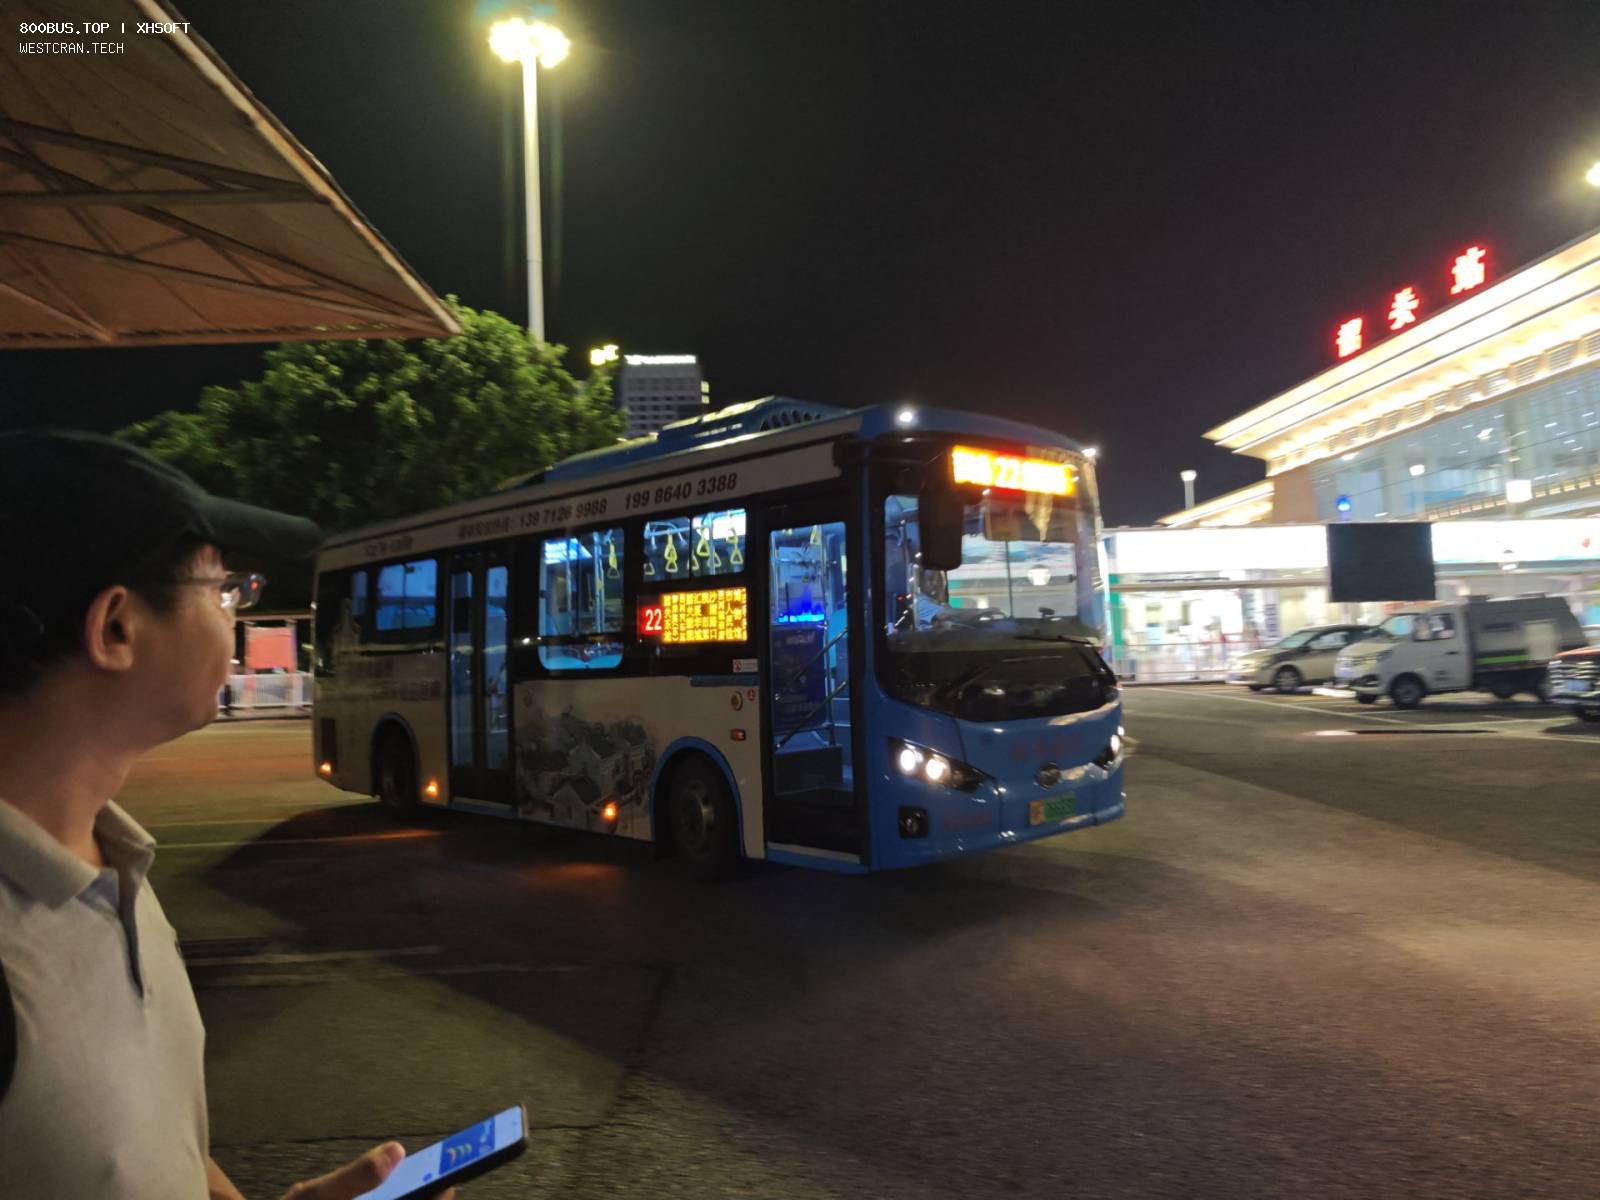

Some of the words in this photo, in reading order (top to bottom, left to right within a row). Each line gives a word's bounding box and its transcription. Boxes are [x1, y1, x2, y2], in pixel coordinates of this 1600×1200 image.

[519, 510, 540, 528] 139
[543, 504, 572, 523] 7126
[576, 498, 607, 519] 9988
[625, 490, 650, 510] 199
[654, 481, 692, 505] 8640
[697, 473, 738, 496] 3388
[645, 608, 662, 631] 22
